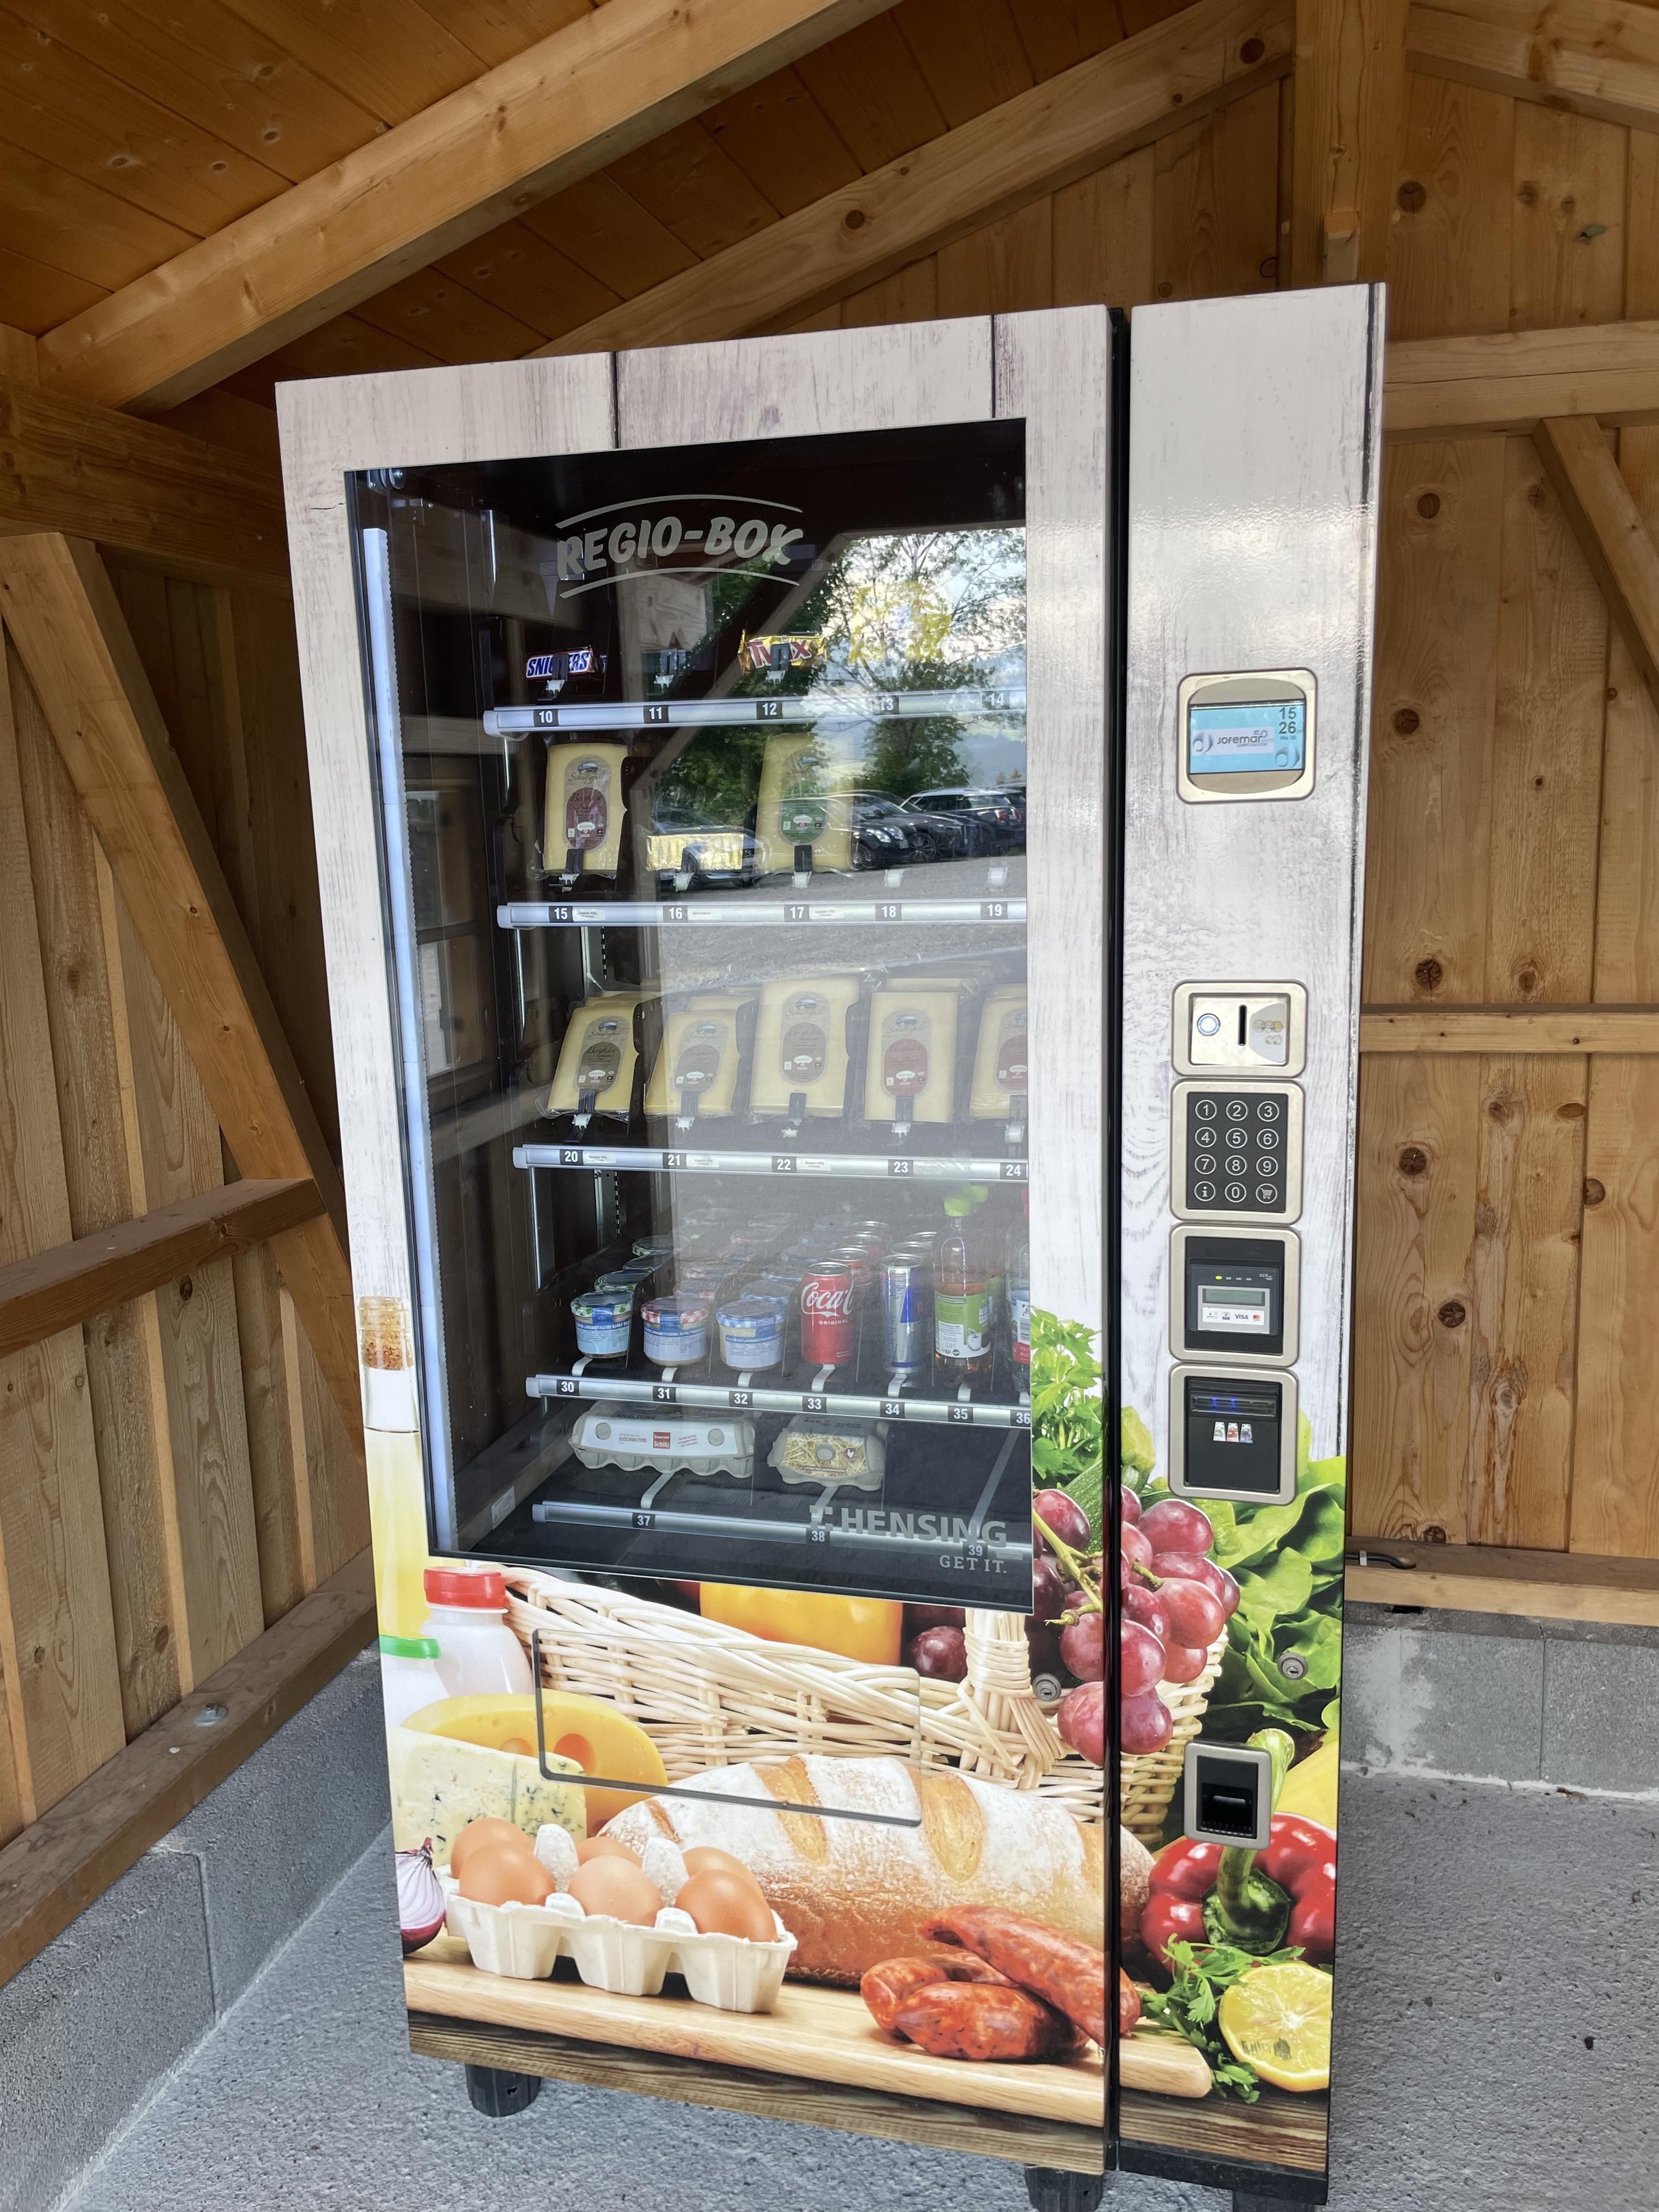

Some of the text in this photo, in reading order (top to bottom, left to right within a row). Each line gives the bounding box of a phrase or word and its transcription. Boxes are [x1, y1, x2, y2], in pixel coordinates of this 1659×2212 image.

[557, 516, 804, 581] REGIO-BOX
[879, 697, 894, 711] 13
[989, 692, 1005, 706] 14
[649, 707, 662, 720] 11
[762, 702, 778, 716] 12
[1279, 707, 1297, 720] 15
[539, 711, 553, 724] 10
[1278, 721, 1296, 734] 26
[554, 907, 568, 920] 15
[669, 907, 683, 920] 16
[790, 906, 805, 919] 17
[881, 905, 896, 918] 18
[987, 904, 1002, 917] 19
[1202, 1104, 1272, 1118] 1 2 3
[1201, 1131, 1272, 1145] 4 5 6
[564, 1150, 578, 1162] 20
[667, 1154, 680, 1166] 21
[776, 1159, 791, 1171] 22
[893, 1162, 909, 1174] 23
[1005, 1164, 1021, 1177] 24
[1201, 1159, 1271, 1172] 7 8 9
[1231, 1186, 1240, 1198] 0
[561, 1381, 575, 1393] 30
[658, 1387, 670, 1399] 31
[734, 1393, 748, 1405] 32
[807, 1397, 822, 1410] 33
[885, 1403, 900, 1416] 34
[953, 1407, 968, 1420] 35
[1016, 1412, 1031, 1425] 36
[637, 1515, 651, 1527] 37
[841, 1507, 1006, 1548] HENSING
[811, 1530, 826, 1542] 38
[968, 1545, 983, 1557] 39
[940, 1554, 1007, 1574] GET IT.
